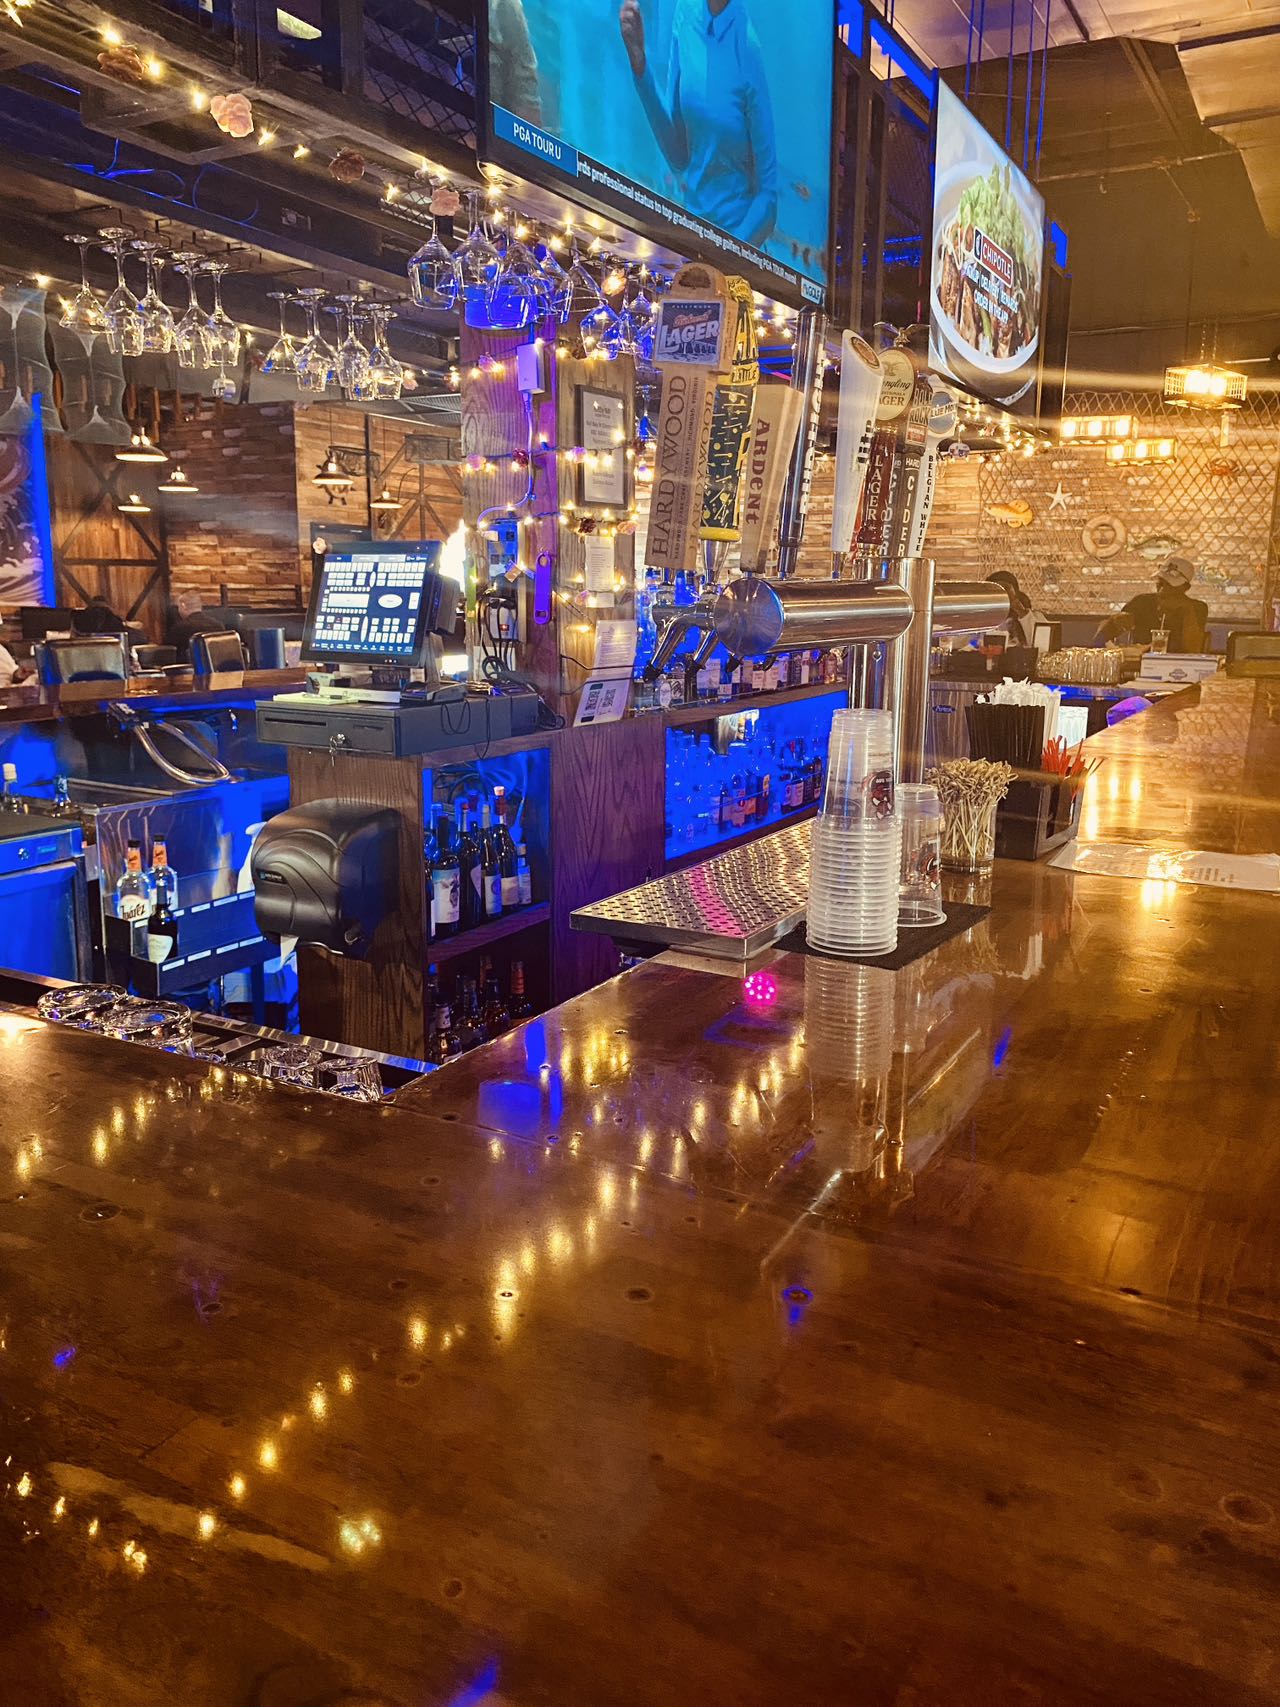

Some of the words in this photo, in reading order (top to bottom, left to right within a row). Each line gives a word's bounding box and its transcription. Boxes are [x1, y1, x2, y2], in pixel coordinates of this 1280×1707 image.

[513, 122, 531, 145] PGA
[532, 132, 555, 157] TOUR
[555, 147, 562, 160] U
[591, 166, 634, 200] professional
[634, 190, 655, 210] status
[982, 240, 1012, 280] CHIPOTLE
[808, 285, 821, 300] GOLF
[658, 320, 720, 353] LAGER
[879, 395, 905, 406] GER
[883, 379, 911, 391] ngling
[651, 375, 687, 558] HARDYWOOD
[689, 391, 713, 550] HARDYWOOD
[905, 457, 920, 468] HARD
[922, 455, 934, 509] BELGIAN
[867, 454, 883, 521] LAGER
[897, 475, 915, 558] CIDER
[915, 513, 927, 552] WHITE
